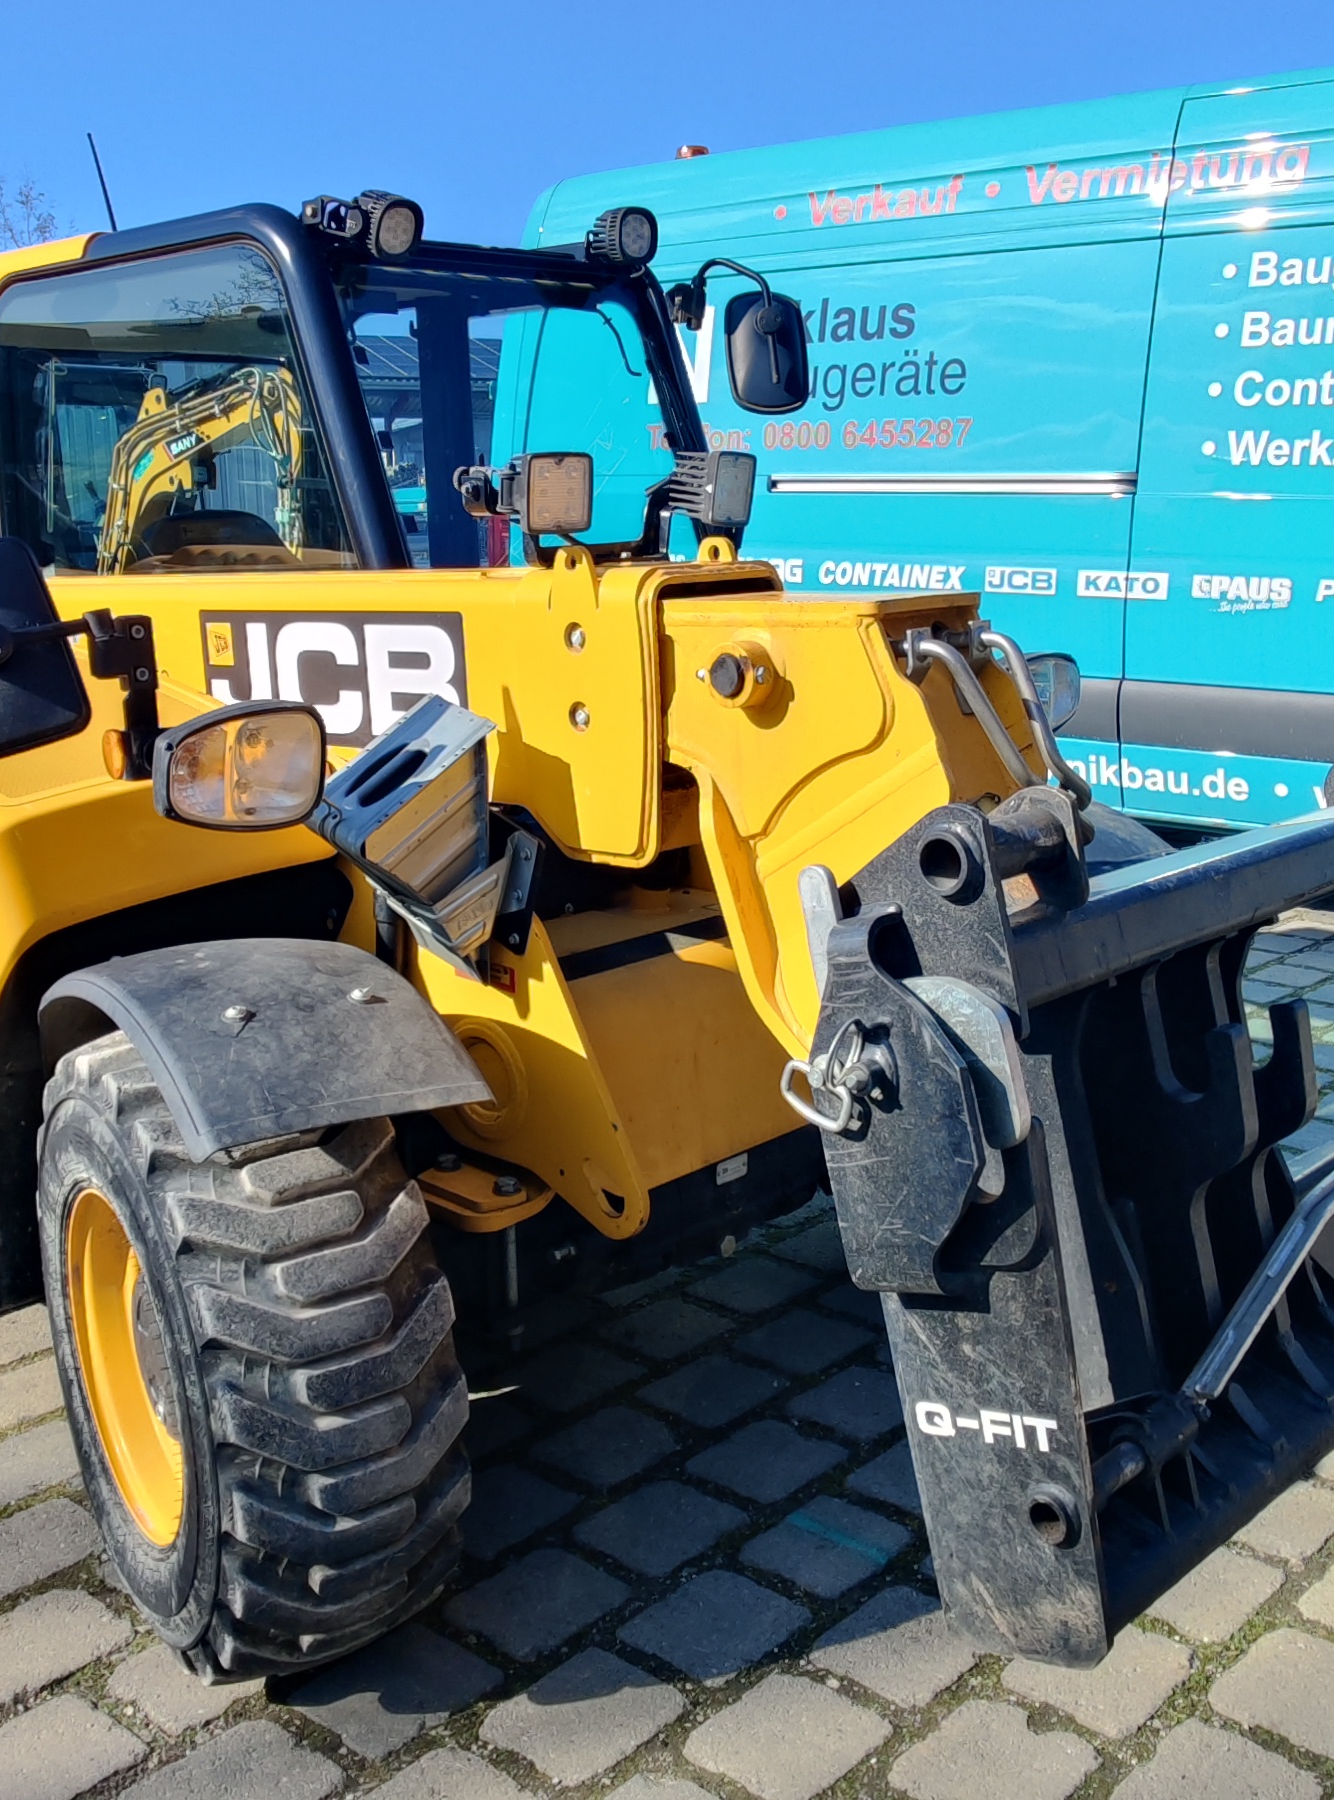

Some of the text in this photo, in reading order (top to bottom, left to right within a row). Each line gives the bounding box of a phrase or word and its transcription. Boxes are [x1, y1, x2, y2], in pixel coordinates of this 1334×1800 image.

[807, 173, 965, 226] Verkauf
[1023, 145, 1311, 205] Vermietung
[802, 297, 917, 344] klaus
[809, 348, 967, 412] geräte
[170, 433, 197, 455] SANY
[763, 420, 832, 450] 0800
[841, 416, 974, 449] 6455287
[818, 559, 967, 590] CONTAINEX
[987, 568, 1054, 592] JCB
[1083, 575, 1161, 595] KATO
[210, 621, 461, 736] JCB
[1048, 754, 1250, 801] nikbau.de
[915, 1401, 1058, 1452] Q-FIT
